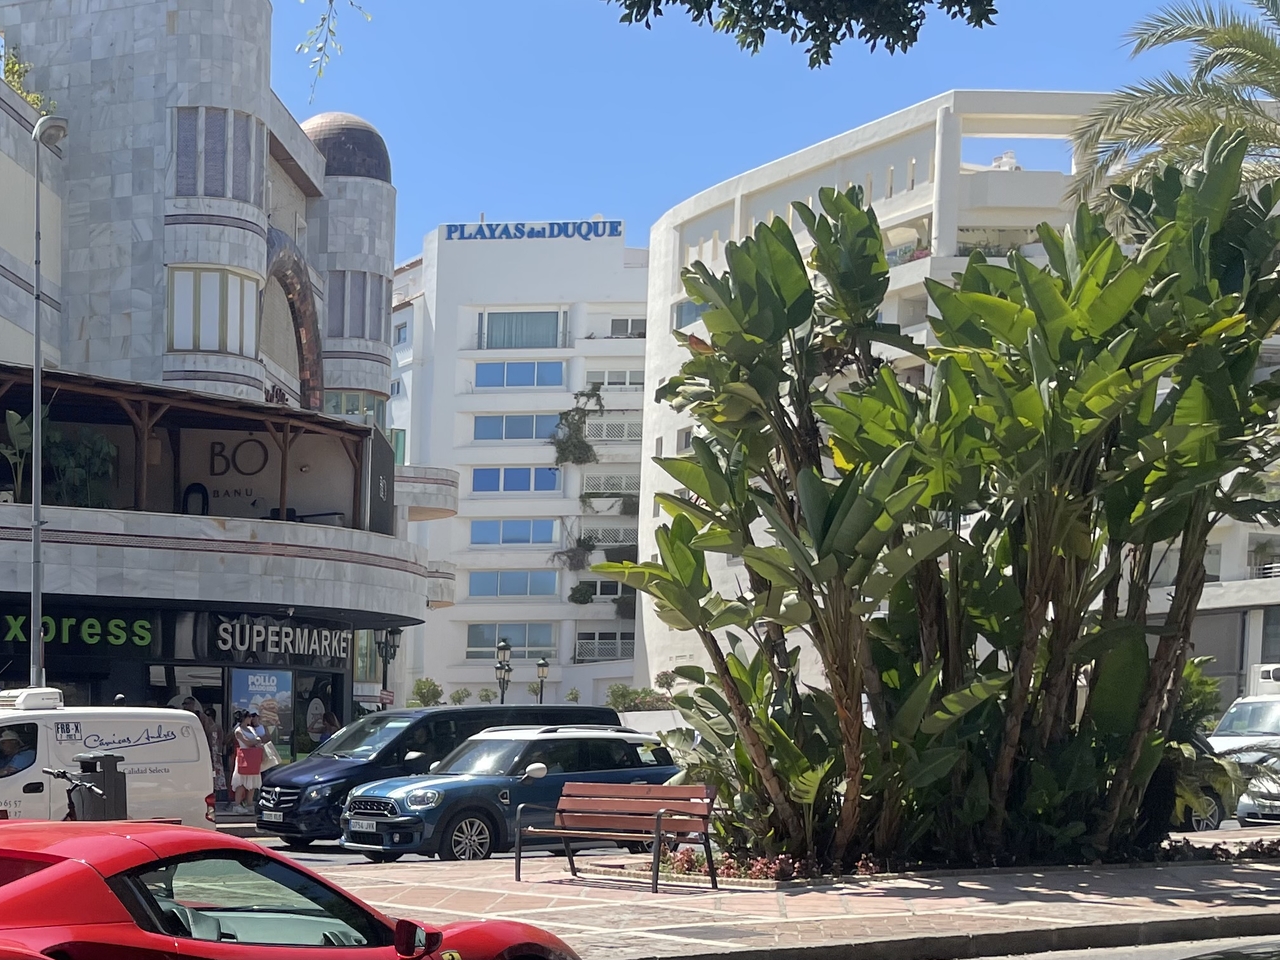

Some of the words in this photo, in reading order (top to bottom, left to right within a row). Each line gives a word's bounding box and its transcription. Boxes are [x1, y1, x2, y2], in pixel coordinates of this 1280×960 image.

[445, 222, 525, 241] PLAYAS
[527, 226, 546, 239] del
[548, 220, 622, 241] DUQUE
[209, 438, 269, 476] BO
[217, 622, 353, 659] SUPERMARKET
[248, 674, 277, 686] POLLO
[123, 767, 147, 775] Calidad
[149, 766, 170, 774] Selecta
